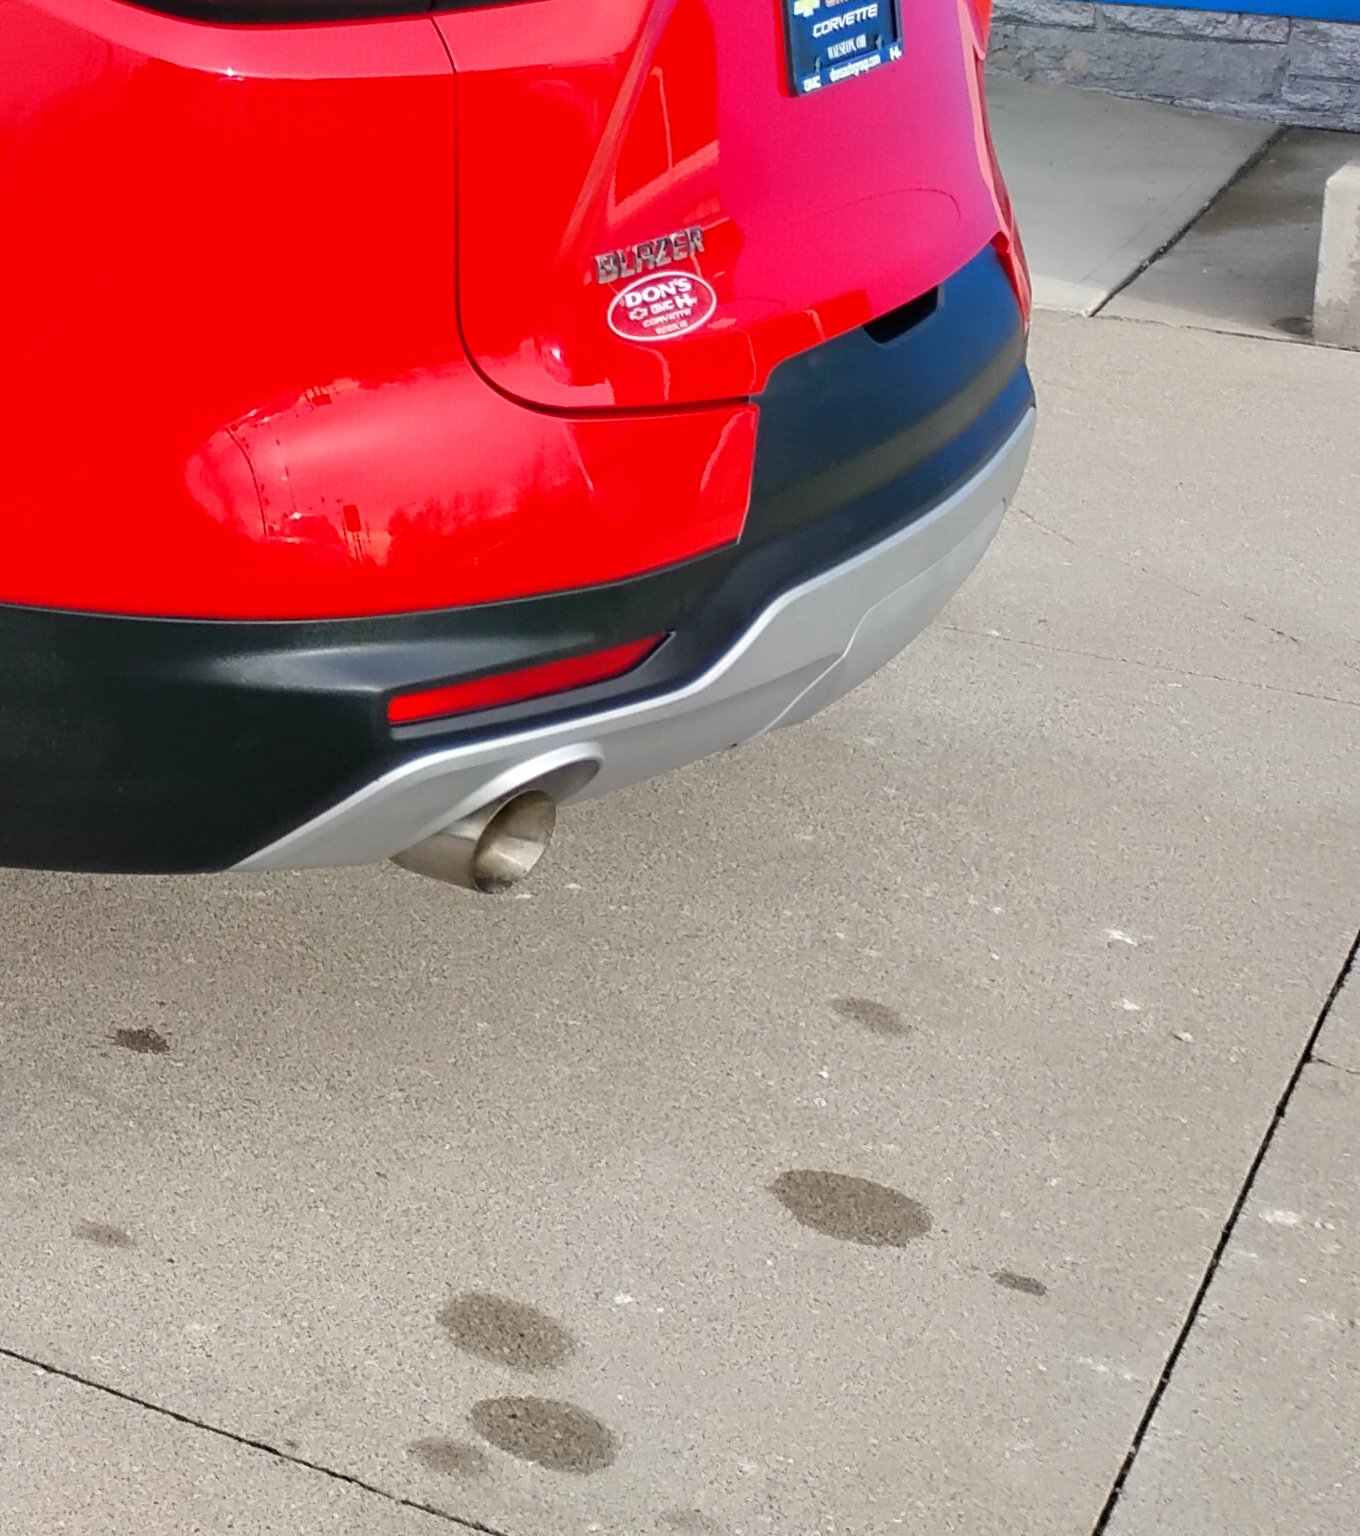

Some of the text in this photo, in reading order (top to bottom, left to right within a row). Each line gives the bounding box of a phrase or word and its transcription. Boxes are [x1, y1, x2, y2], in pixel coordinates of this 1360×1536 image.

[812, 3, 879, 39] CORVETTE
[594, 225, 705, 285] BLAZER
[624, 277, 693, 309] DON'S
